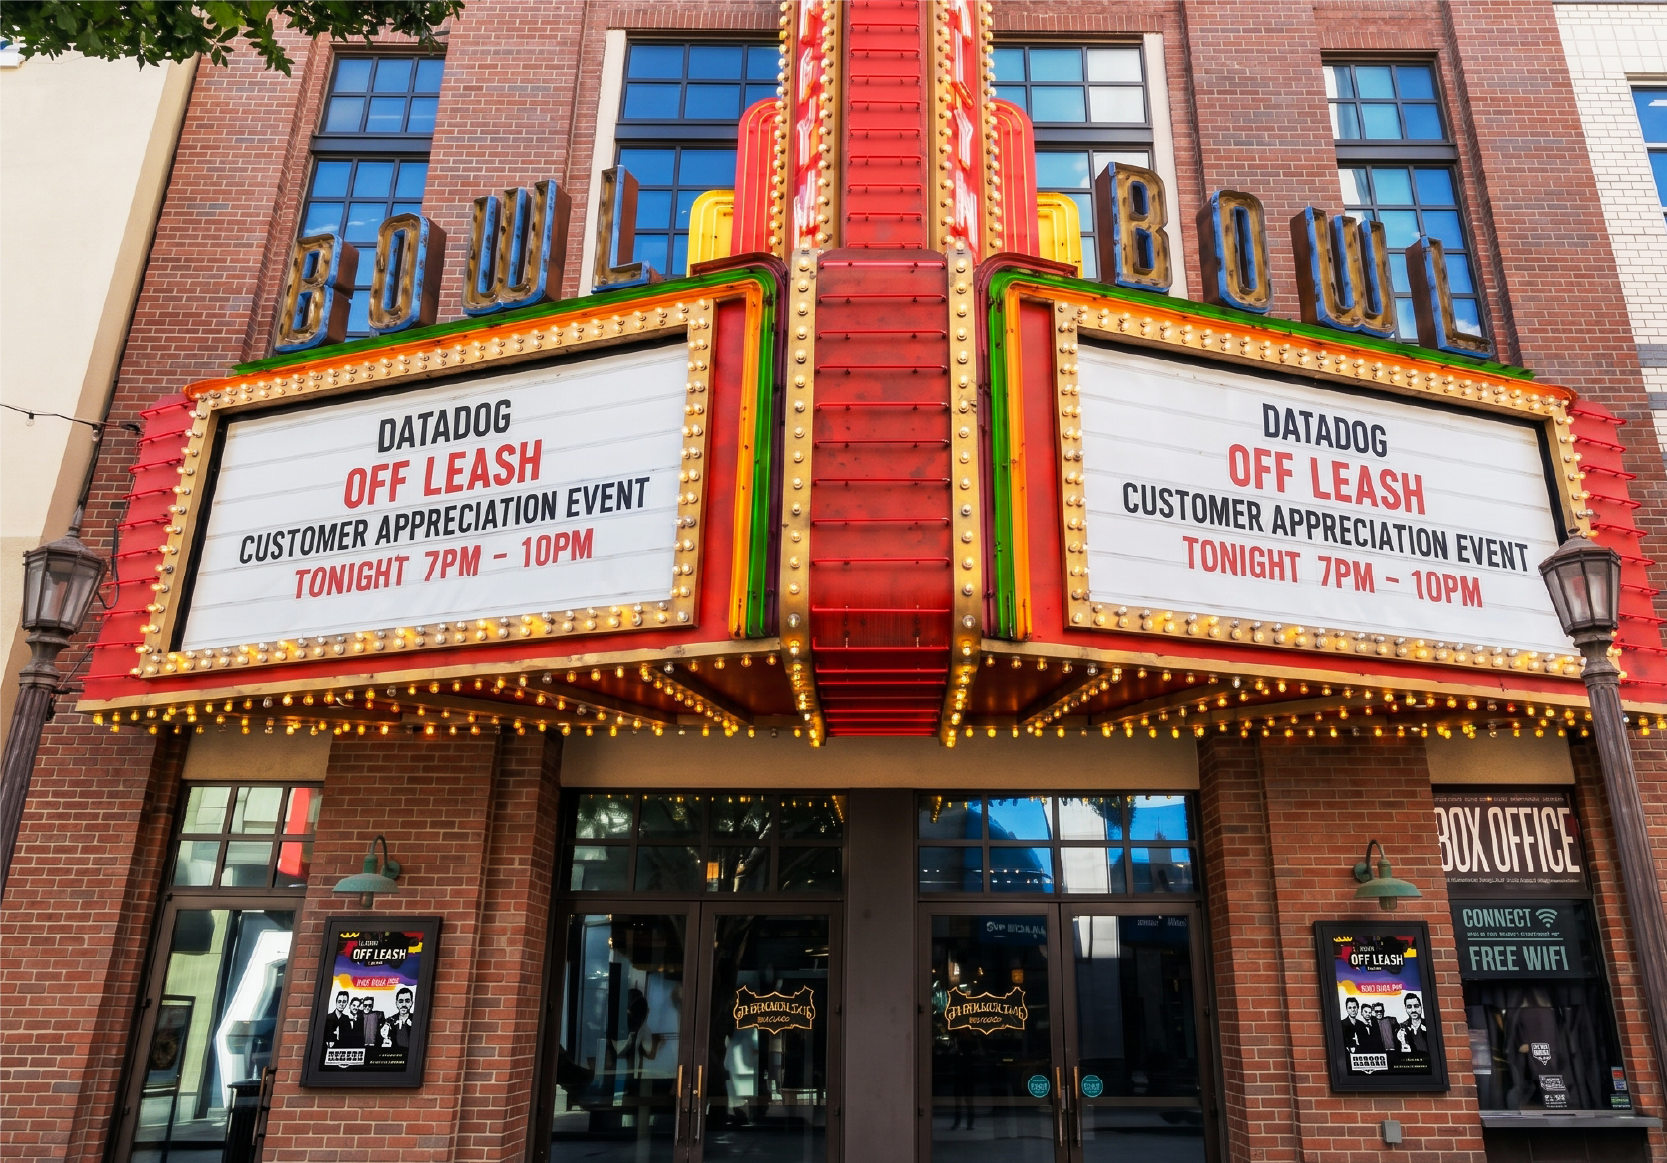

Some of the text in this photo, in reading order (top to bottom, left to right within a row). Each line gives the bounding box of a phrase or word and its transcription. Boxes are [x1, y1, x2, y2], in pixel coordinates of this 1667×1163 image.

[274, 164, 656, 354] BOWL
[1095, 161, 1494, 359] BOWL
[378, 400, 511, 453] DATADOG
[1263, 403, 1388, 457] DATADOG
[344, 439, 543, 509] OFF LEASH
[1229, 444, 1426, 515] OFF LEASH
[239, 477, 650, 564] CUSTOMER APPRECIATION EVENT
[1122, 482, 1528, 572] CUSTOMER APPRECIATION EVENT
[295, 555, 410, 599] TONIGHT
[424, 545, 482, 582] 7PM
[522, 528, 594, 568] 10PM
[1183, 536, 1300, 583] TONIGHT
[1318, 556, 1375, 593] 7PM
[1411, 570, 1483, 608] 10PM
[1434, 806, 1581, 873] BOX OFFICE
[1462, 908, 1532, 928] CONNECT
[353, 948, 407, 960] OFF LEASH
[1351, 954, 1404, 966] OFF LEASH
[1469, 945, 1570, 971] FREE WIFI
